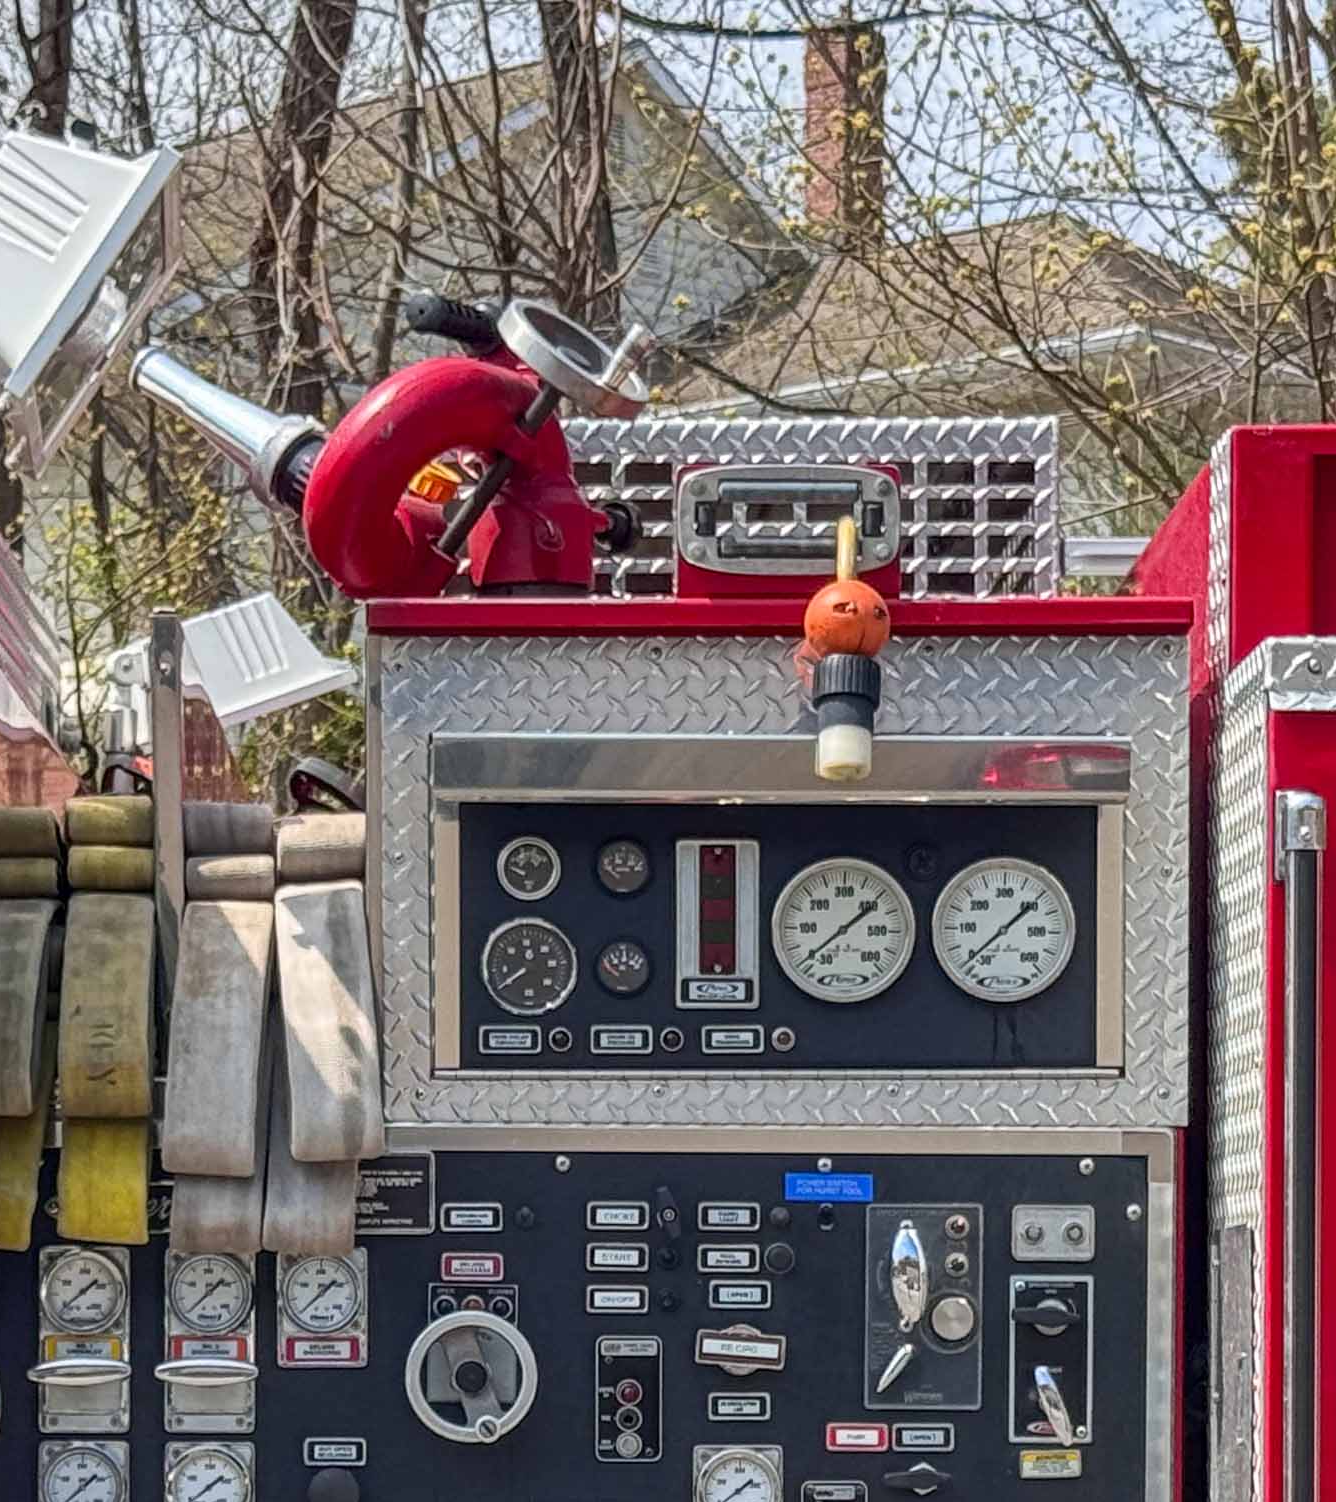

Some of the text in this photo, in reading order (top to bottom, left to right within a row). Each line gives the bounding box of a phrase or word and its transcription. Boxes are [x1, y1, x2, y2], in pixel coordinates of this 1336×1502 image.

[834, 886, 855, 898] 300
[995, 887, 1015, 899] 300
[809, 899, 830, 911] 200
[969, 900, 990, 911] 200
[799, 922, 817, 934] 100
[867, 925, 887, 937] 500
[959, 922, 977, 933] 100
[1027, 926, 1047, 938] 500
[860, 951, 881, 962] 600
[1020, 952, 1039, 963] 600
